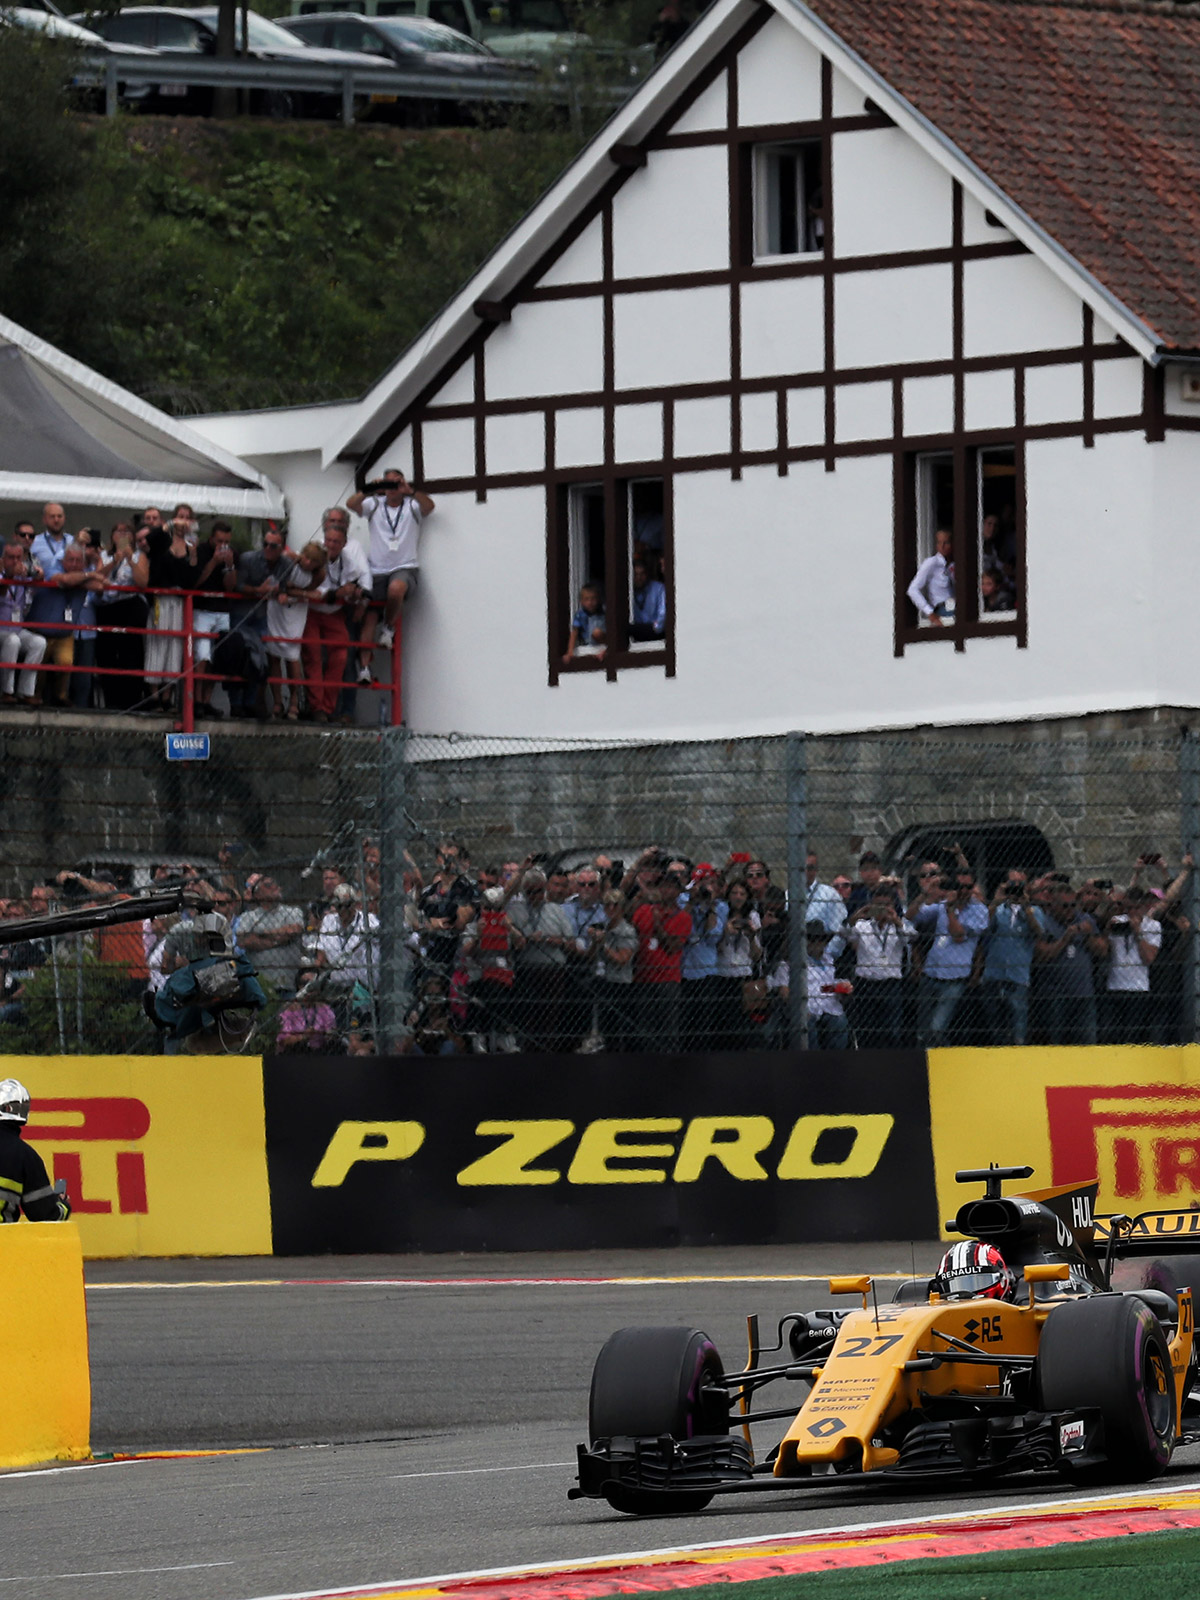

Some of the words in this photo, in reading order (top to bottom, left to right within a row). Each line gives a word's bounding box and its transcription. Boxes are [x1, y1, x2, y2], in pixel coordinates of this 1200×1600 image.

[311, 1120, 425, 1188] P
[456, 1114, 894, 1186] ZERO
[1072, 1196, 1094, 1228] HUL
[941, 1266, 983, 1280] RENAULT
[1181, 1298, 1191, 1333] 27
[836, 1335, 904, 1358] 27
[821, 1404, 860, 1412] Castrol
